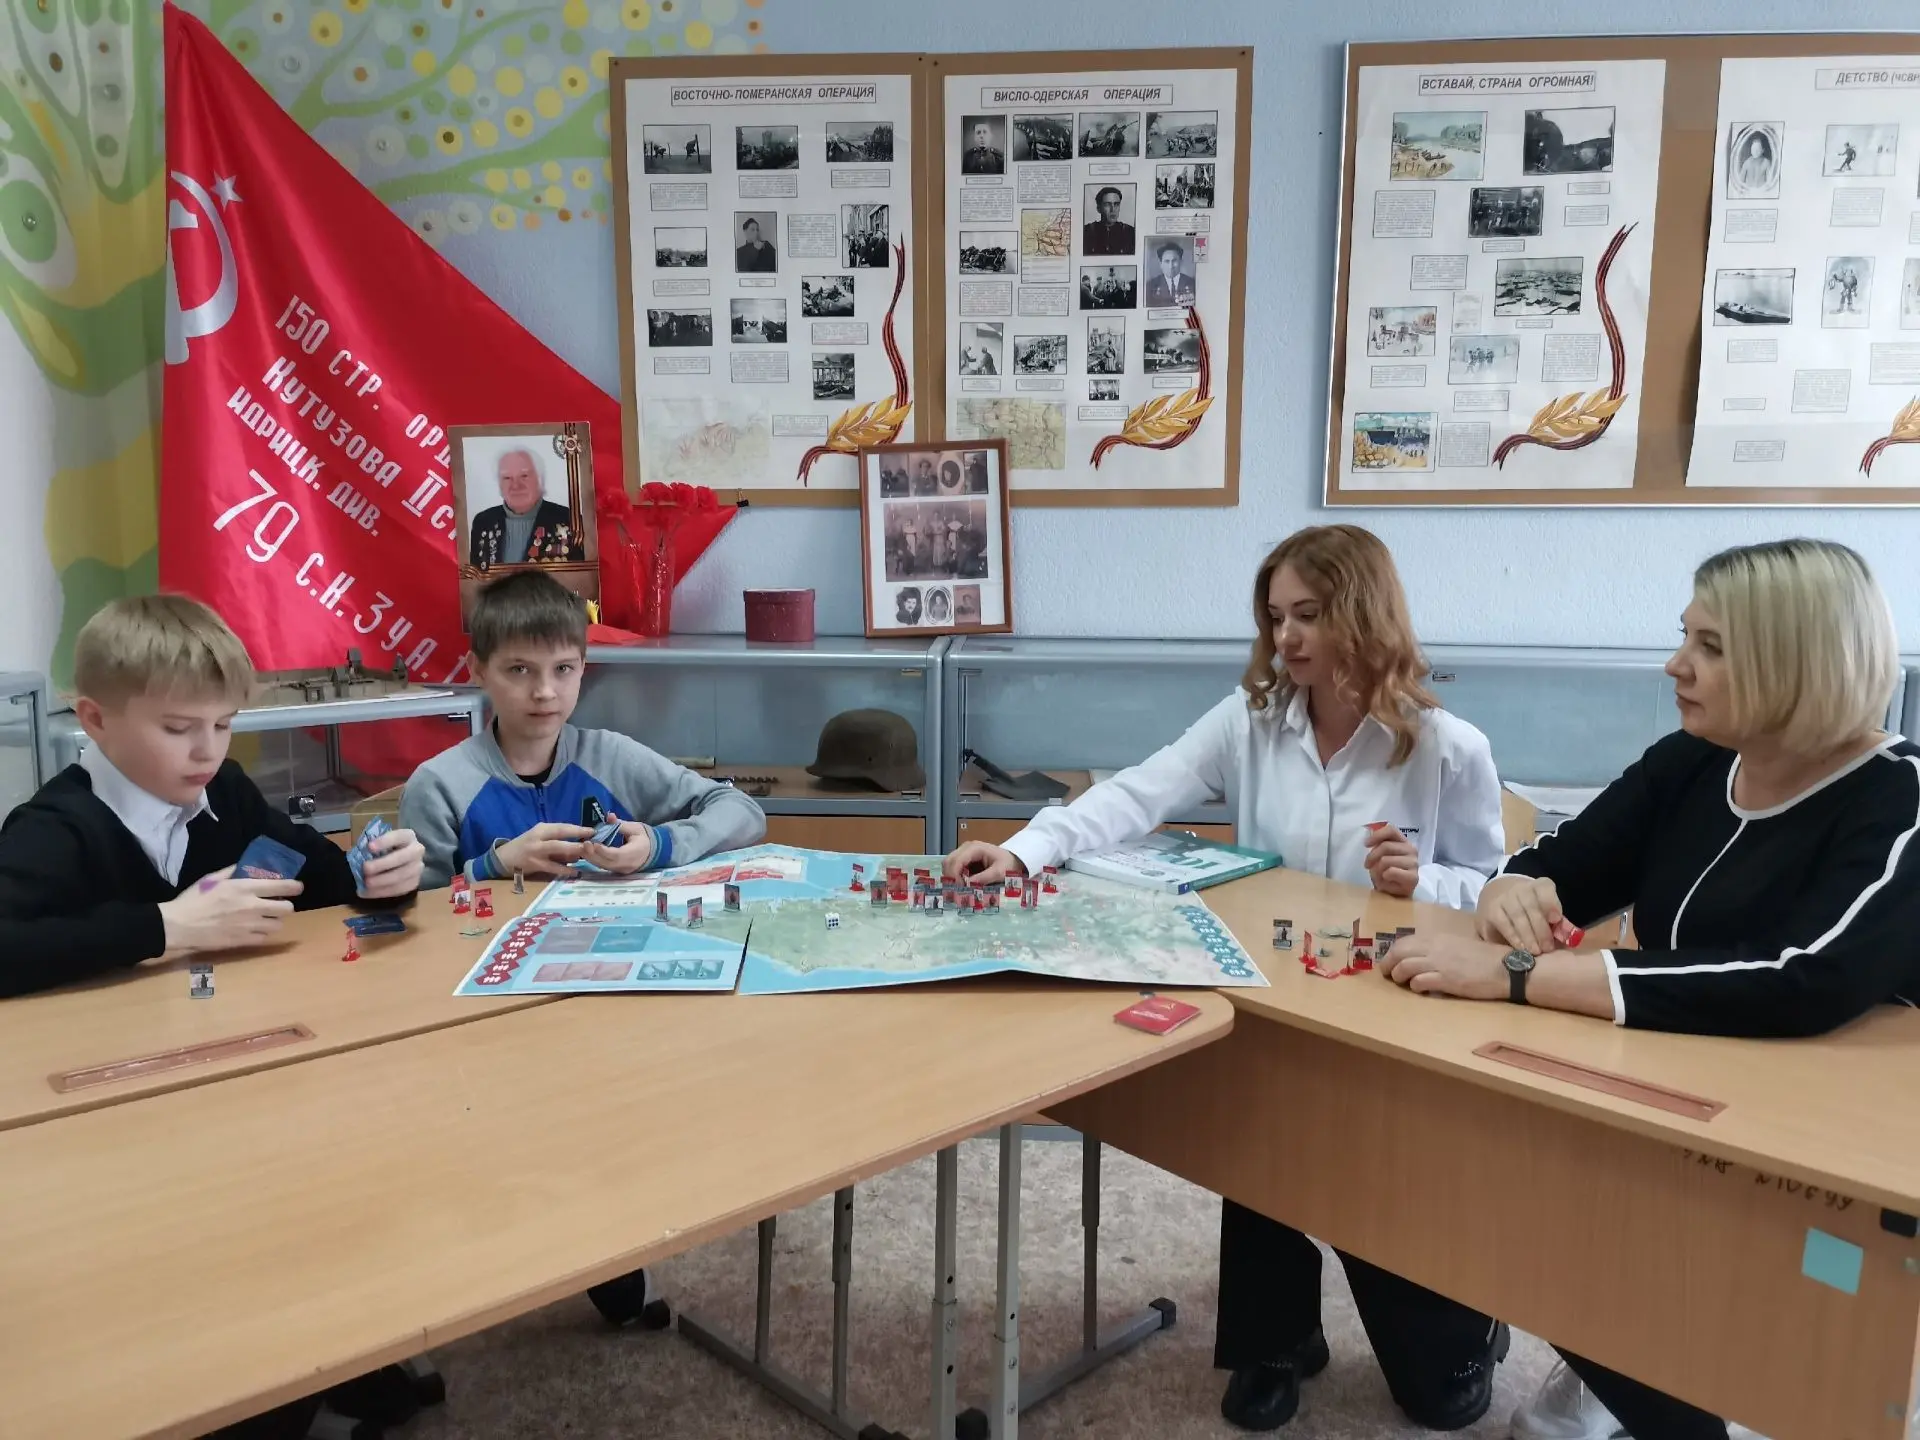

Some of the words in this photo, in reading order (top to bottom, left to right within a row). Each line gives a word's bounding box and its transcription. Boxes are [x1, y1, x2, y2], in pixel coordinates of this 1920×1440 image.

[1421, 75, 1475, 90] ВСТАВАЙ,
[1478, 77, 1522, 89] СТРАНА
[1528, 74, 1594, 88] ОГРОМНАЯ!
[1835, 71, 1889, 86] ДЕТСТВО
[818, 86, 875, 100] ОПЕРАЦИЯ
[993, 89, 1089, 103] ВИСЛО-ОДЕРСКАЯ
[1103, 88, 1161, 102] ОПЕРАЦИЯ
[275, 294, 330, 355] 150
[328, 349, 383, 411] СТР.
[226, 385, 326, 491] ИДРИЦК.
[326, 481, 381, 538] ДИВ.
[213, 468, 300, 563] 79
